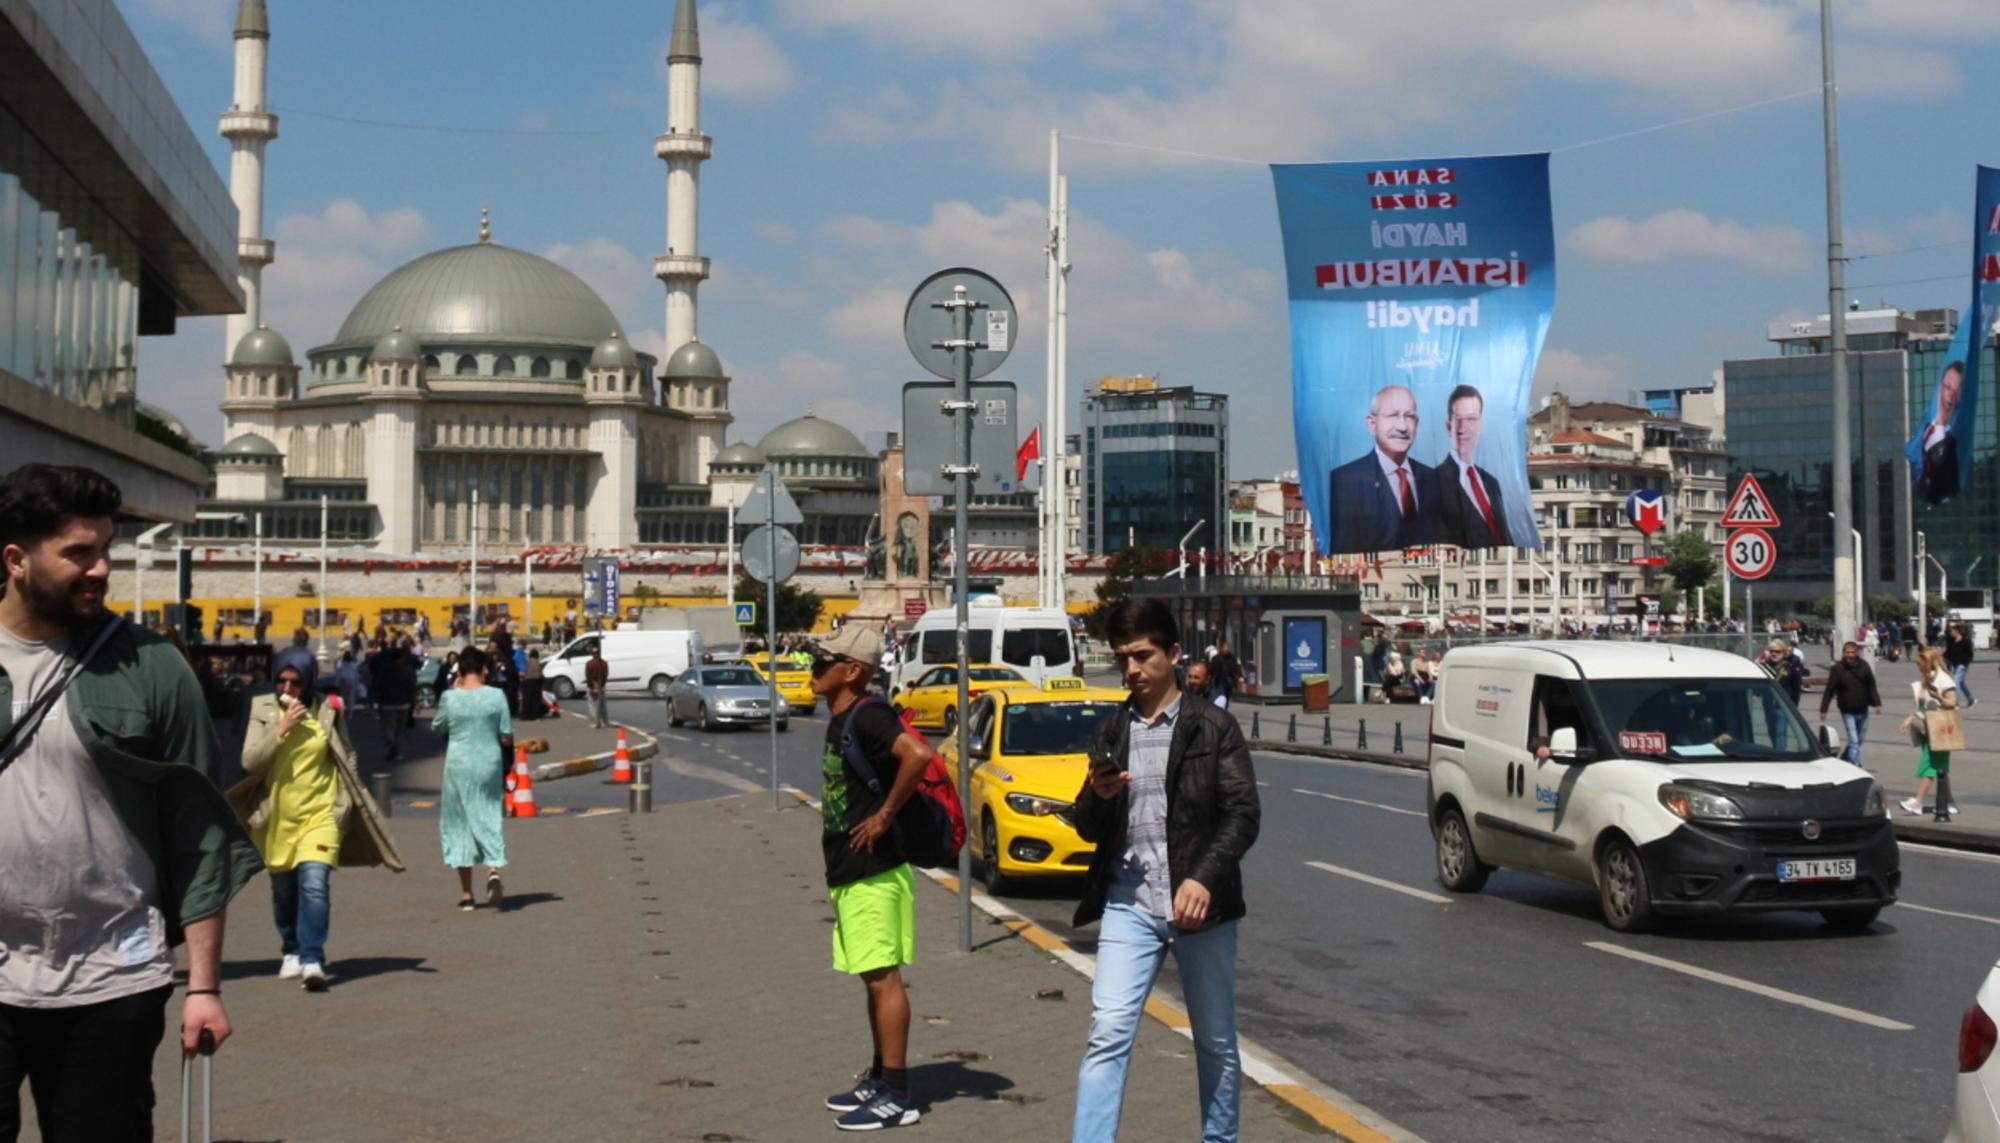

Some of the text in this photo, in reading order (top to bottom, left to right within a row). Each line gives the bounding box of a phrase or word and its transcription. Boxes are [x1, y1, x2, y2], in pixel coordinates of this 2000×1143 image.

[1735, 541, 1764, 565] 30
[606, 565, 615, 588] OTO
[1786, 860, 1852, 877] 34 TV 4165
